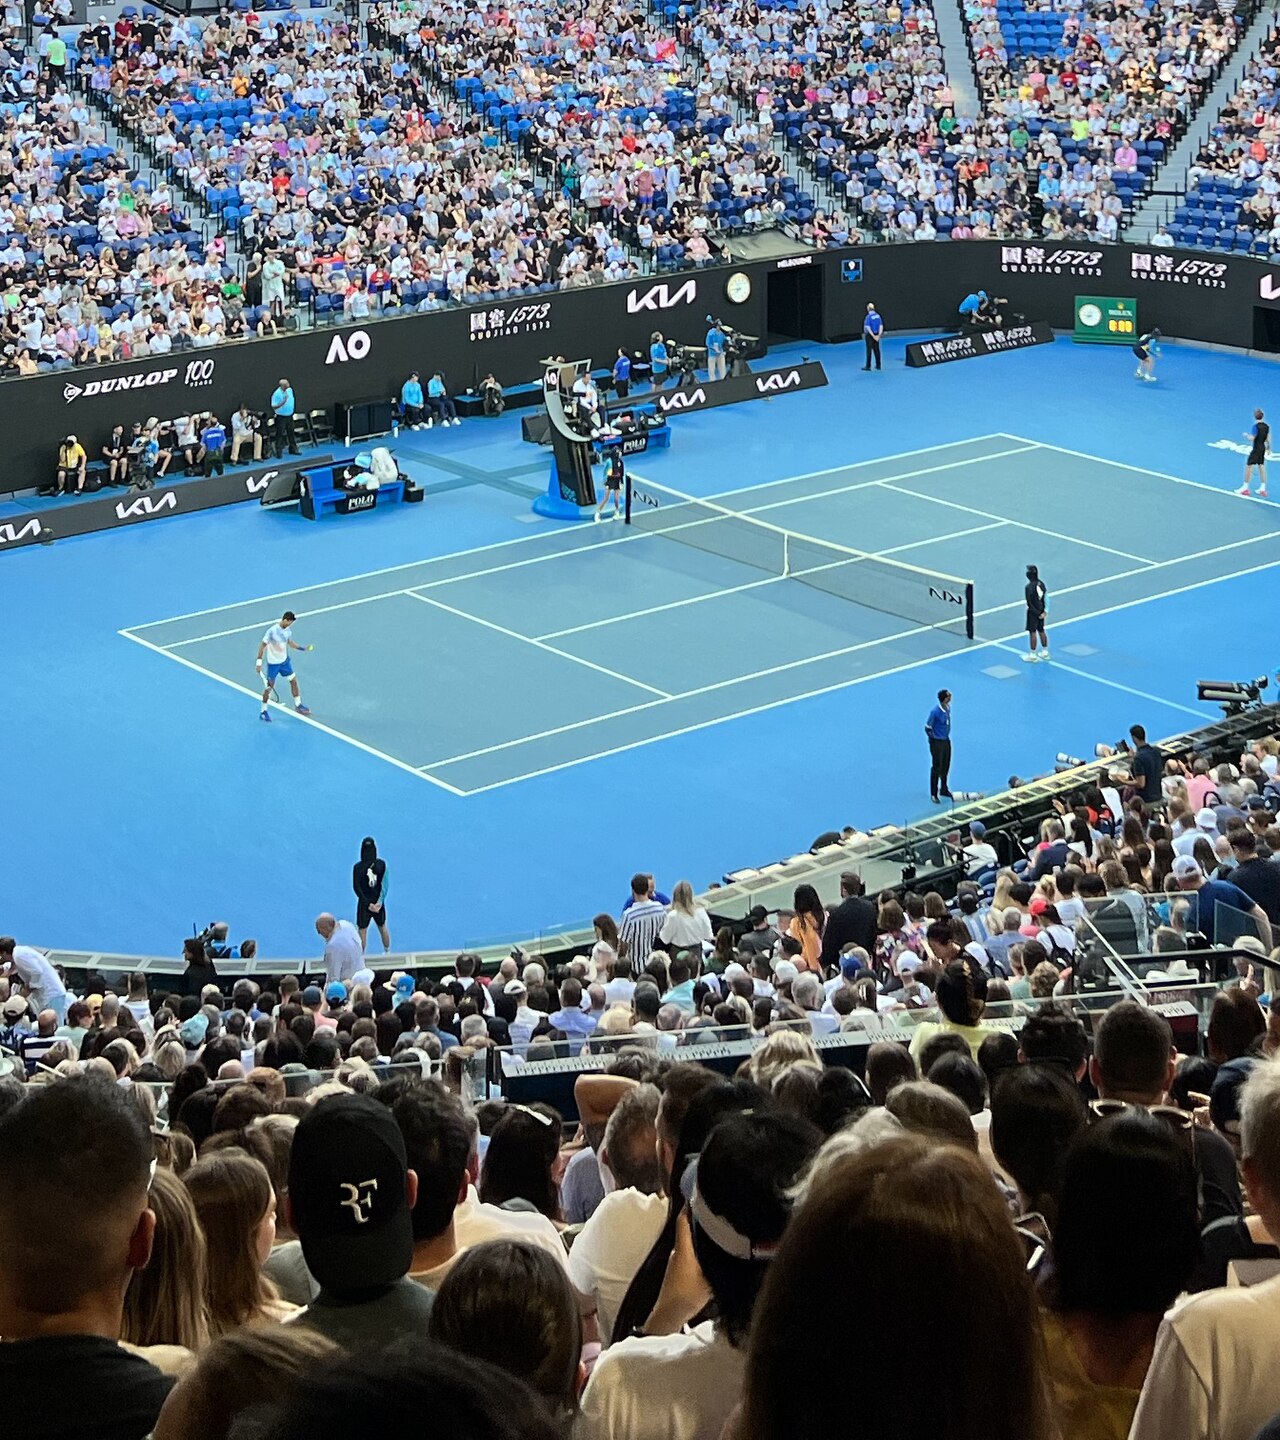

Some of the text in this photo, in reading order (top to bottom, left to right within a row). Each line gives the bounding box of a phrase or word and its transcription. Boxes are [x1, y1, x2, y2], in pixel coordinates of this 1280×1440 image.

[1046, 249, 1103, 266] 1573
[1175, 259, 1228, 278] 1573
[626, 279, 696, 314] KIA
[506, 302, 552, 326] 1573
[945, 337, 972, 352] 1573
[1006, 326, 1032, 341] 1573
[325, 330, 370, 364] AO
[82, 359, 215, 396] DUNLOP 100
[755, 369, 801, 392] KIA
[659, 388, 706, 410] KIA
[623, 438, 646, 450] POLO
[115, 491, 177, 519] KIA
[348, 494, 374, 508] POLO
[340, 1178, 378, 1223] RF
